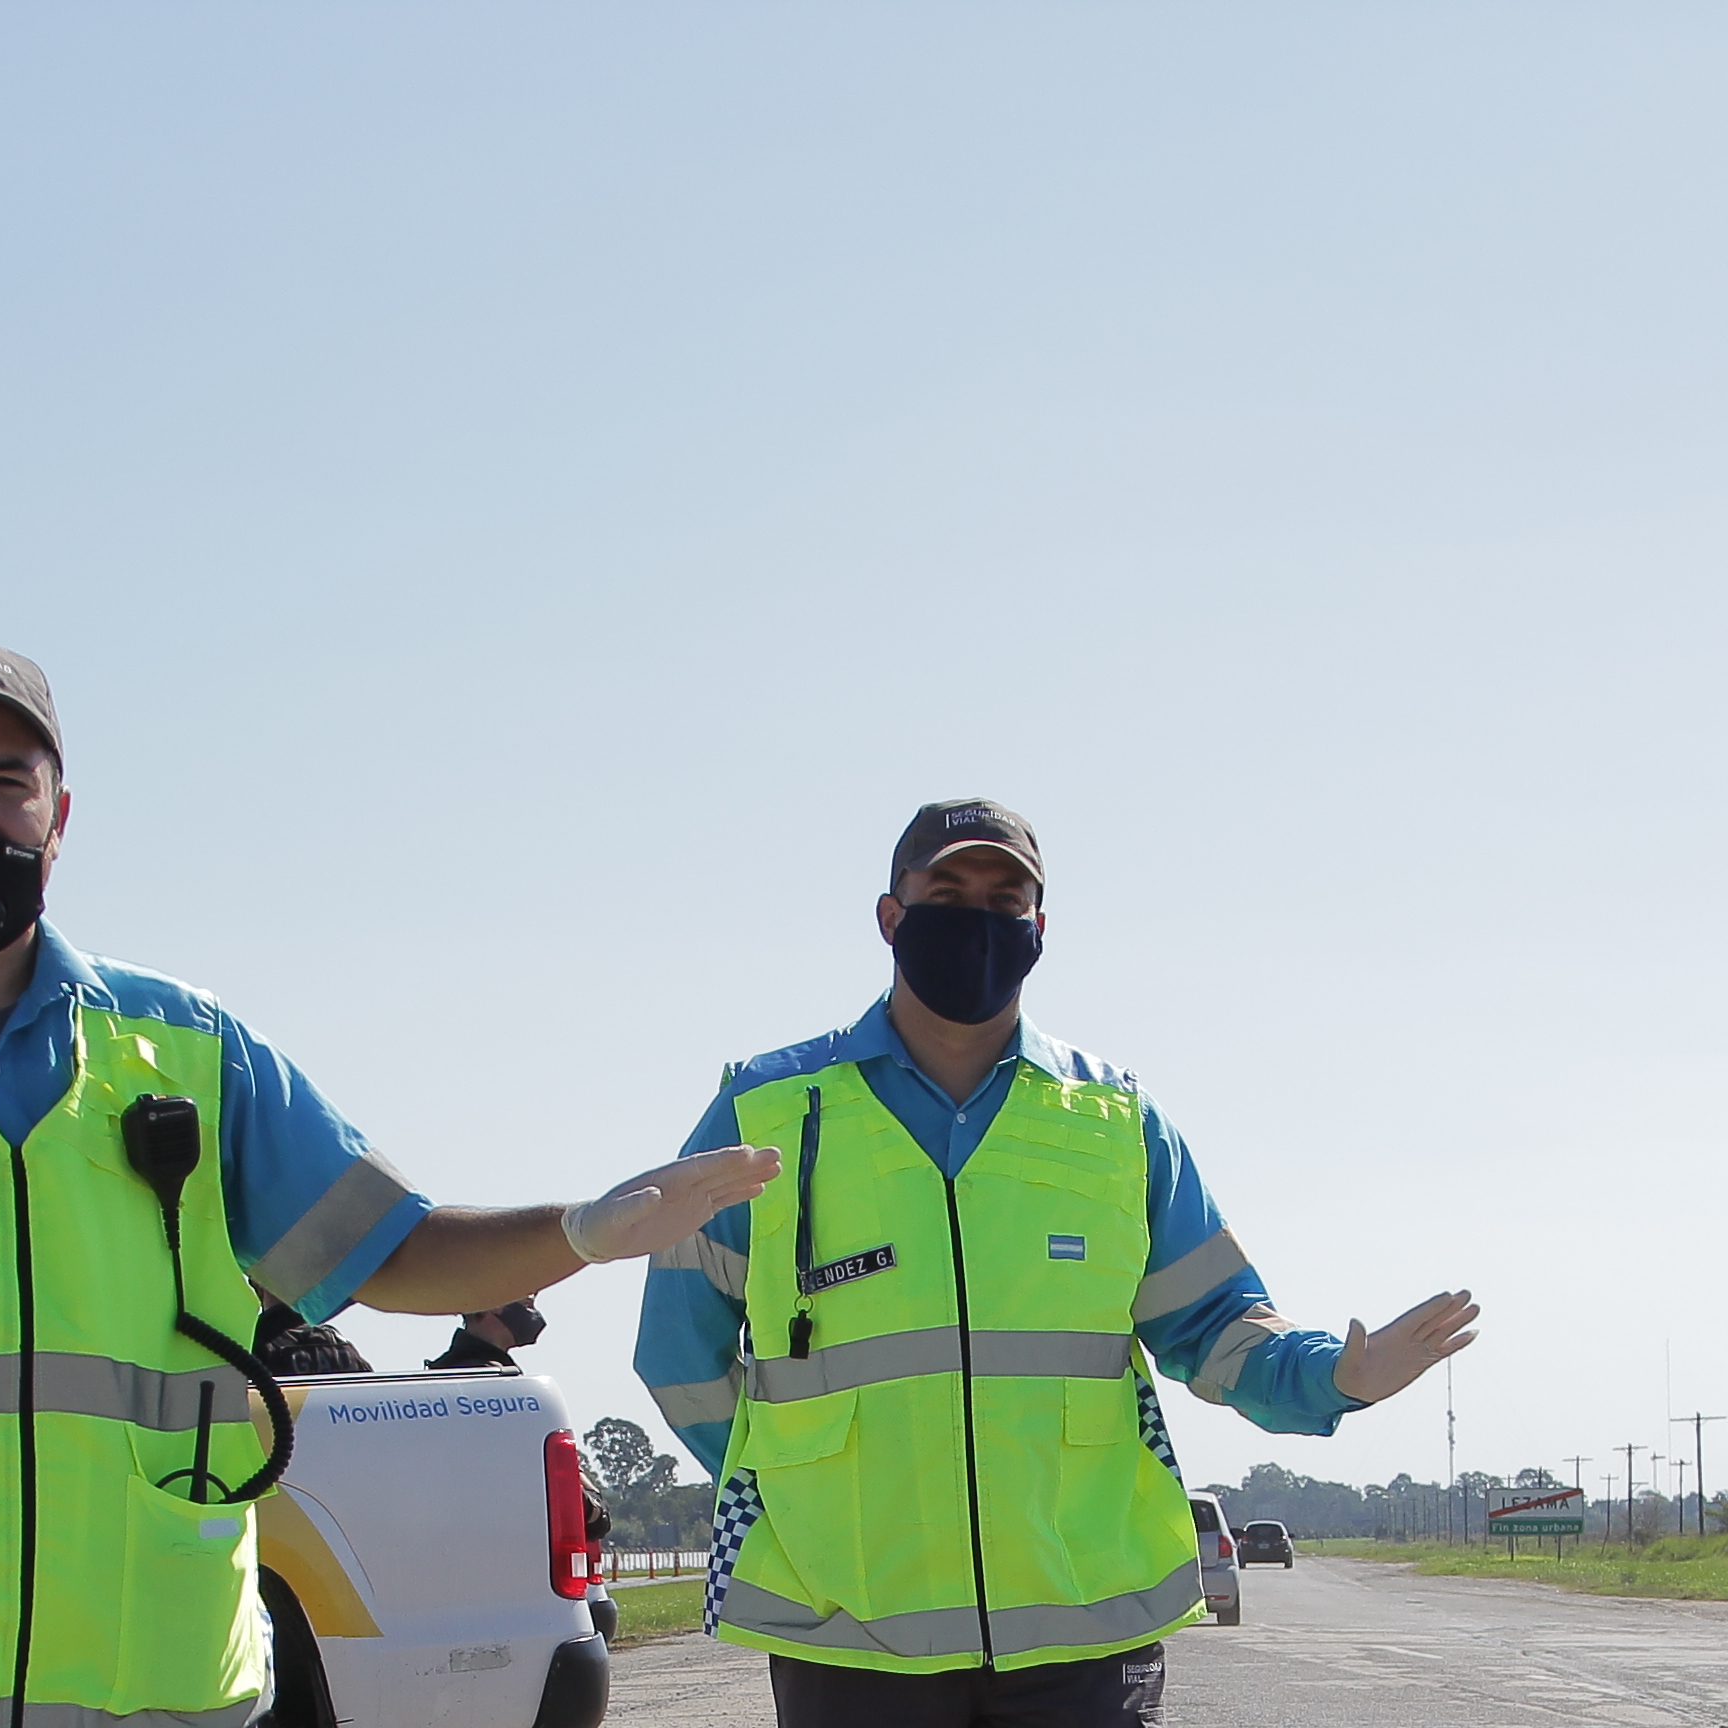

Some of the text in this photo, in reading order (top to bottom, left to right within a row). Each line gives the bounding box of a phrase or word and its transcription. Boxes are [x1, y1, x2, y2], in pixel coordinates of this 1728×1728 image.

[952, 816, 978, 826] VIAL
[815, 1251, 893, 1287] ENDEZ G.
[328, 1396, 540, 1424] Movilidad Segura
[1492, 1523, 1579, 1532] Fin zona urbana
